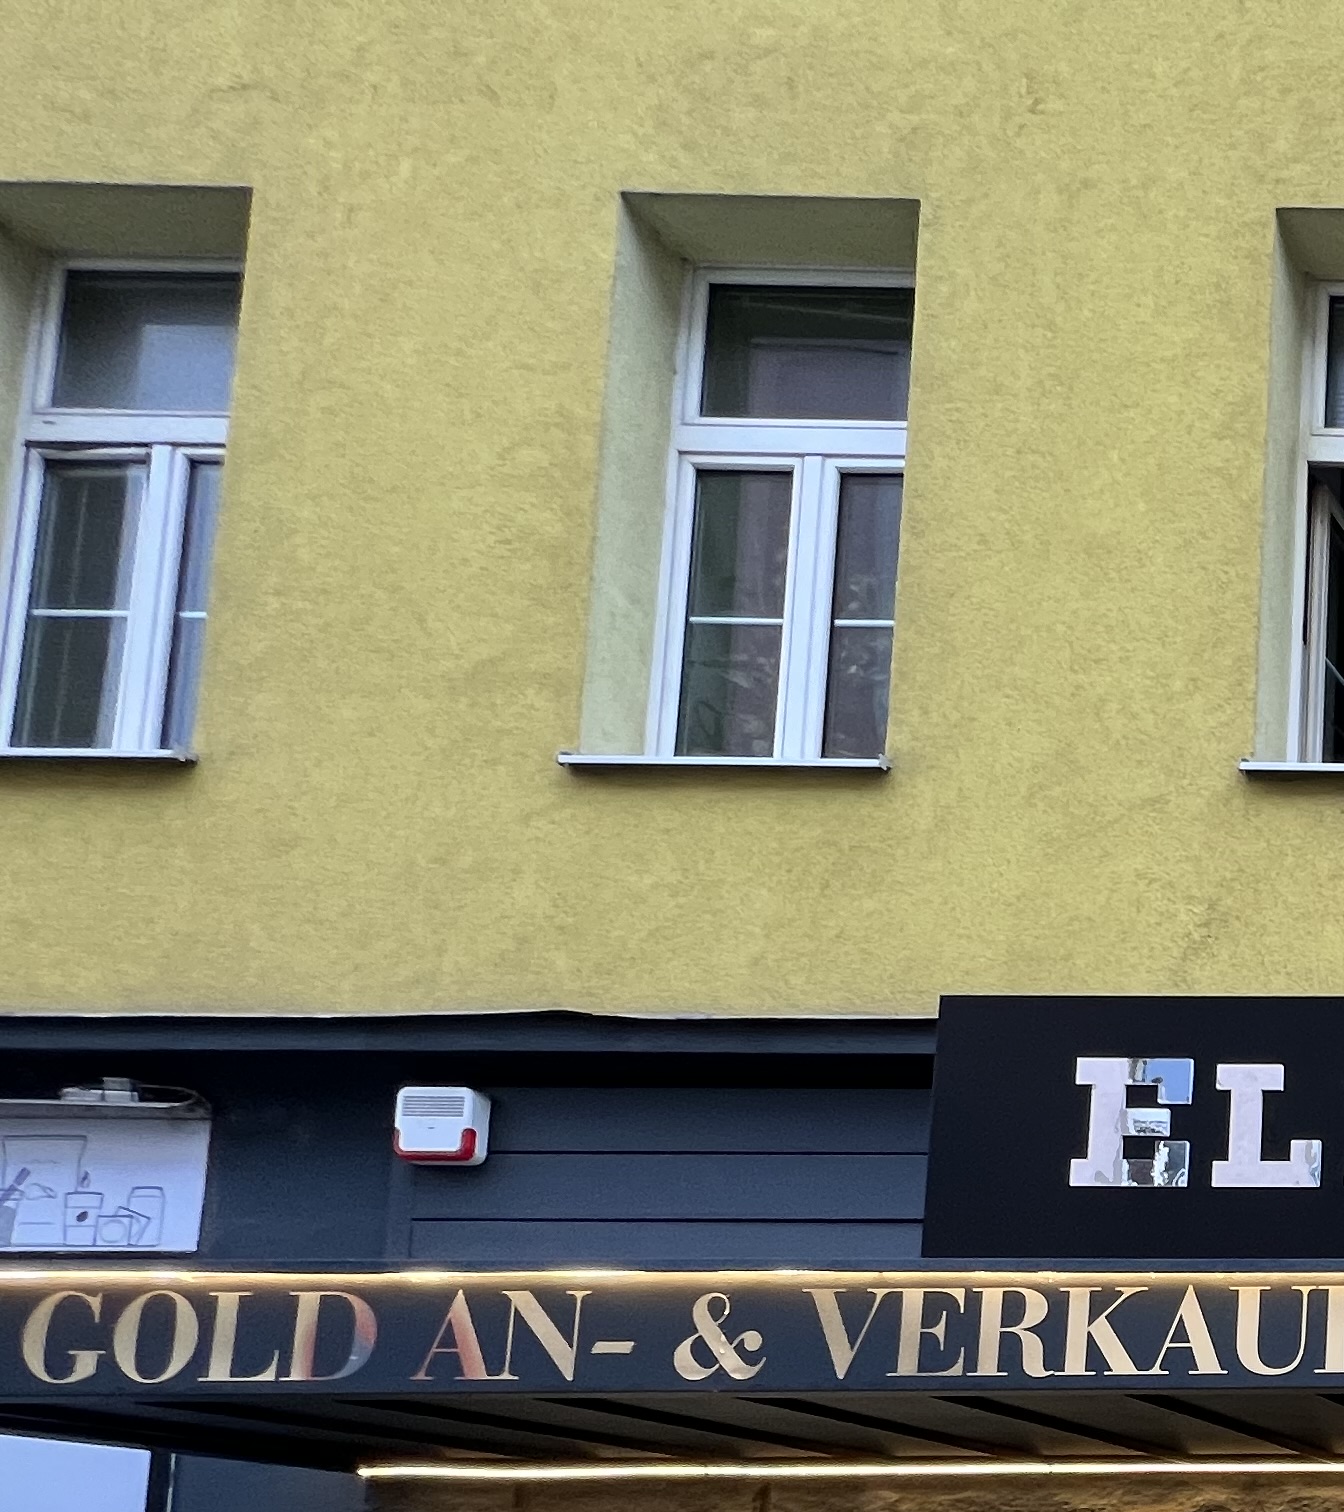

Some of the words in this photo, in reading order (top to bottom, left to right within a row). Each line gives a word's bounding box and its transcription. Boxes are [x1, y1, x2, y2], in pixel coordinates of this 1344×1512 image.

[22, 1289, 378, 1385] GOLD
[411, 1287, 636, 1383] AN-
[673, 1291, 766, 1381] &
